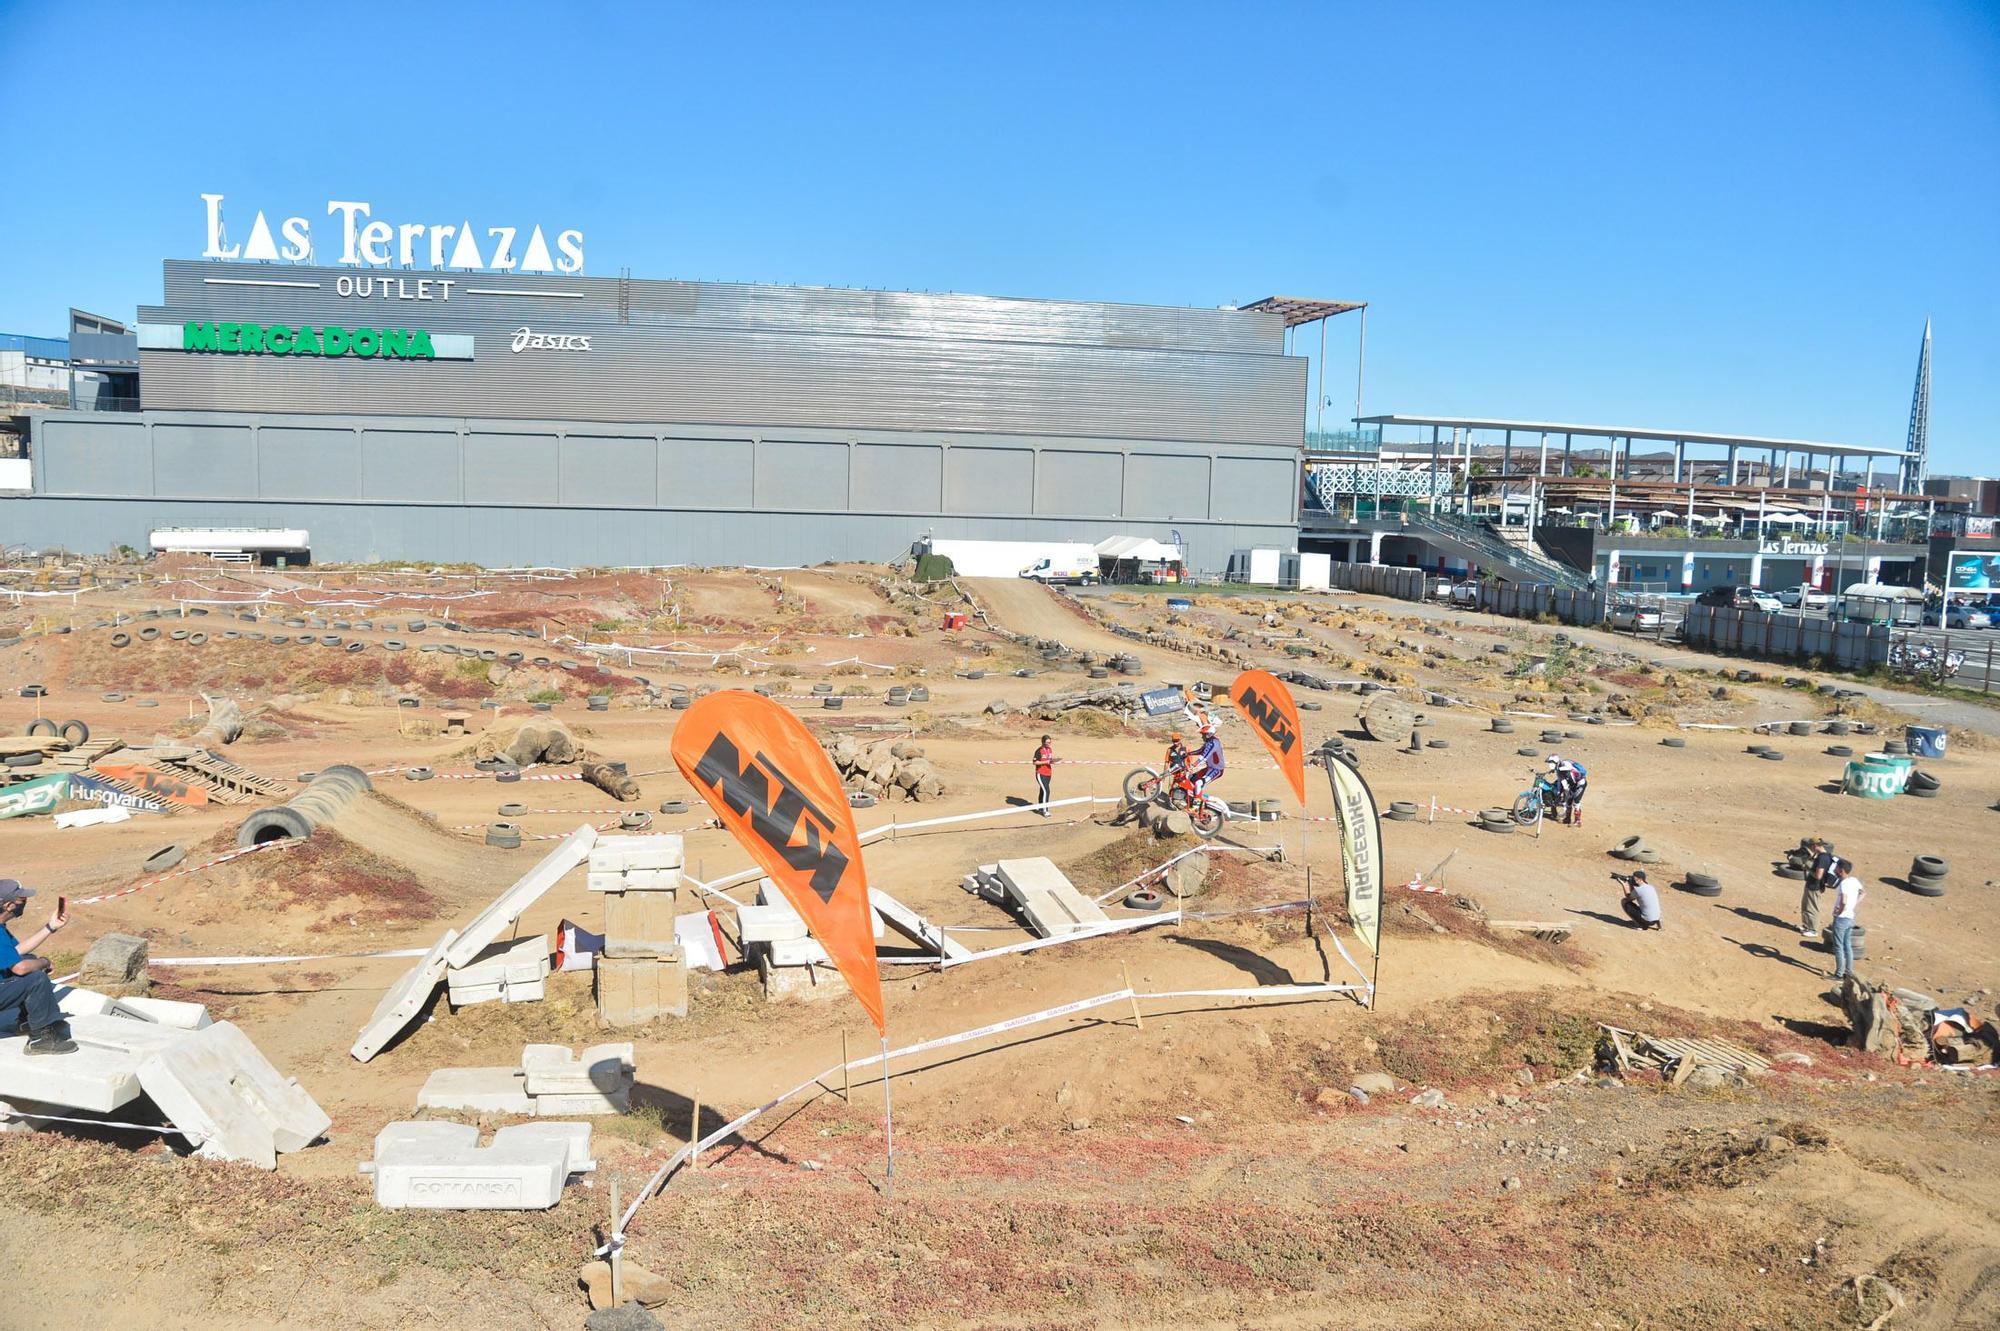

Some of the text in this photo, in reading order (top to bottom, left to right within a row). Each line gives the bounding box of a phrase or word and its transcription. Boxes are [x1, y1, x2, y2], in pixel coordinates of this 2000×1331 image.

[336, 276, 456, 301] OUTLET
[183, 321, 435, 359] MERCADONA
[413, 1182, 519, 1195] COMANSA
